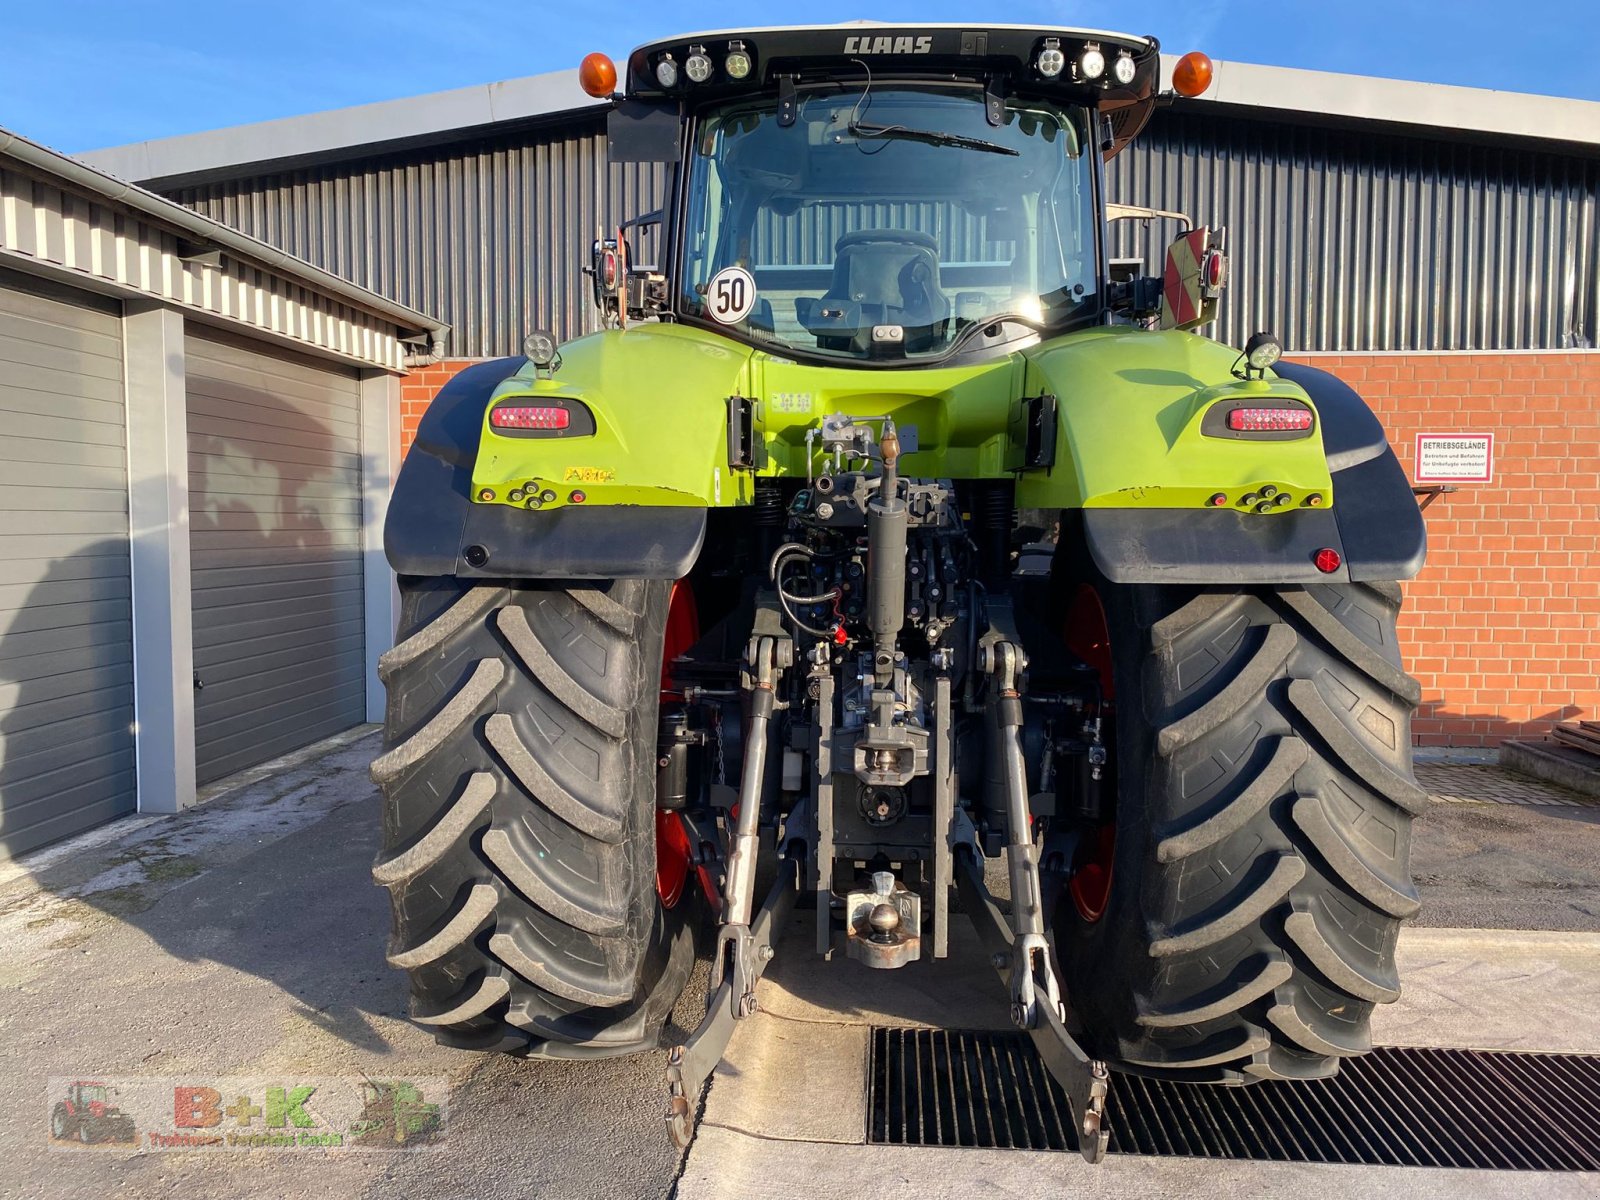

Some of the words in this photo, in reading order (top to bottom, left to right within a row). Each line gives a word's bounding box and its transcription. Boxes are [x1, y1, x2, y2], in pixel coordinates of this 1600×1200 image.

[843, 36, 933, 54] CLAAS
[716, 277, 745, 314] 50
[1423, 441, 1486, 450] BETRIEBSGELÄNDE
